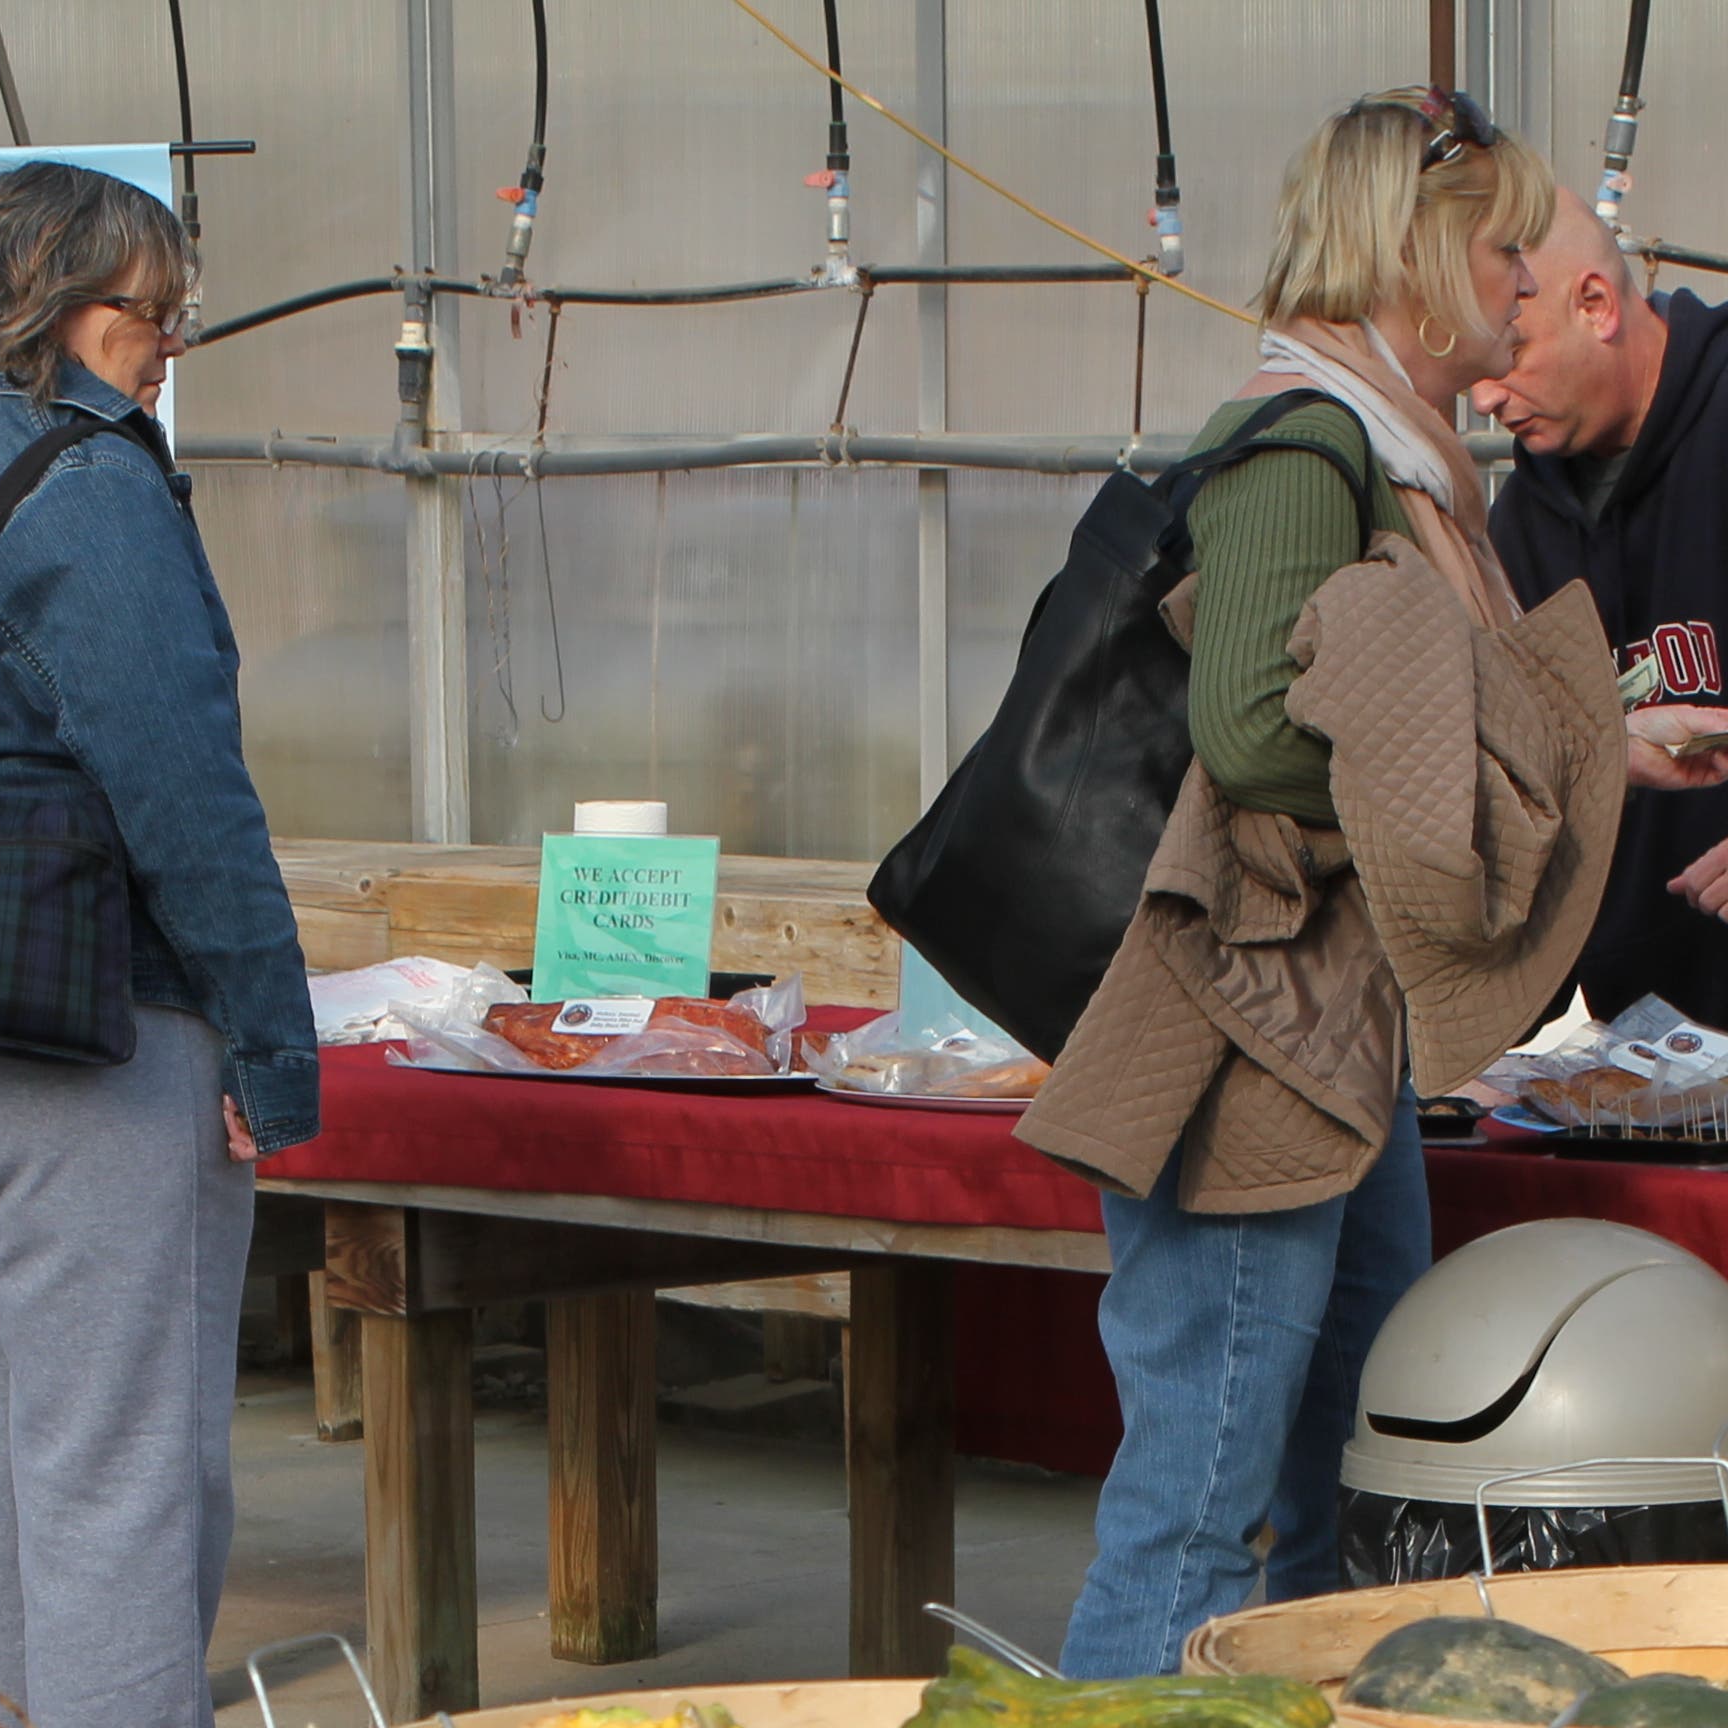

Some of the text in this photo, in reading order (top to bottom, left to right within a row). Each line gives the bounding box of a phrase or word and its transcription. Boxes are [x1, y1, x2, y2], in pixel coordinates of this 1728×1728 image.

[574, 867, 682, 884] WE ACCEPT
[560, 890, 691, 908] CREDIT/DEBIT
[593, 914, 654, 929] CARDS
